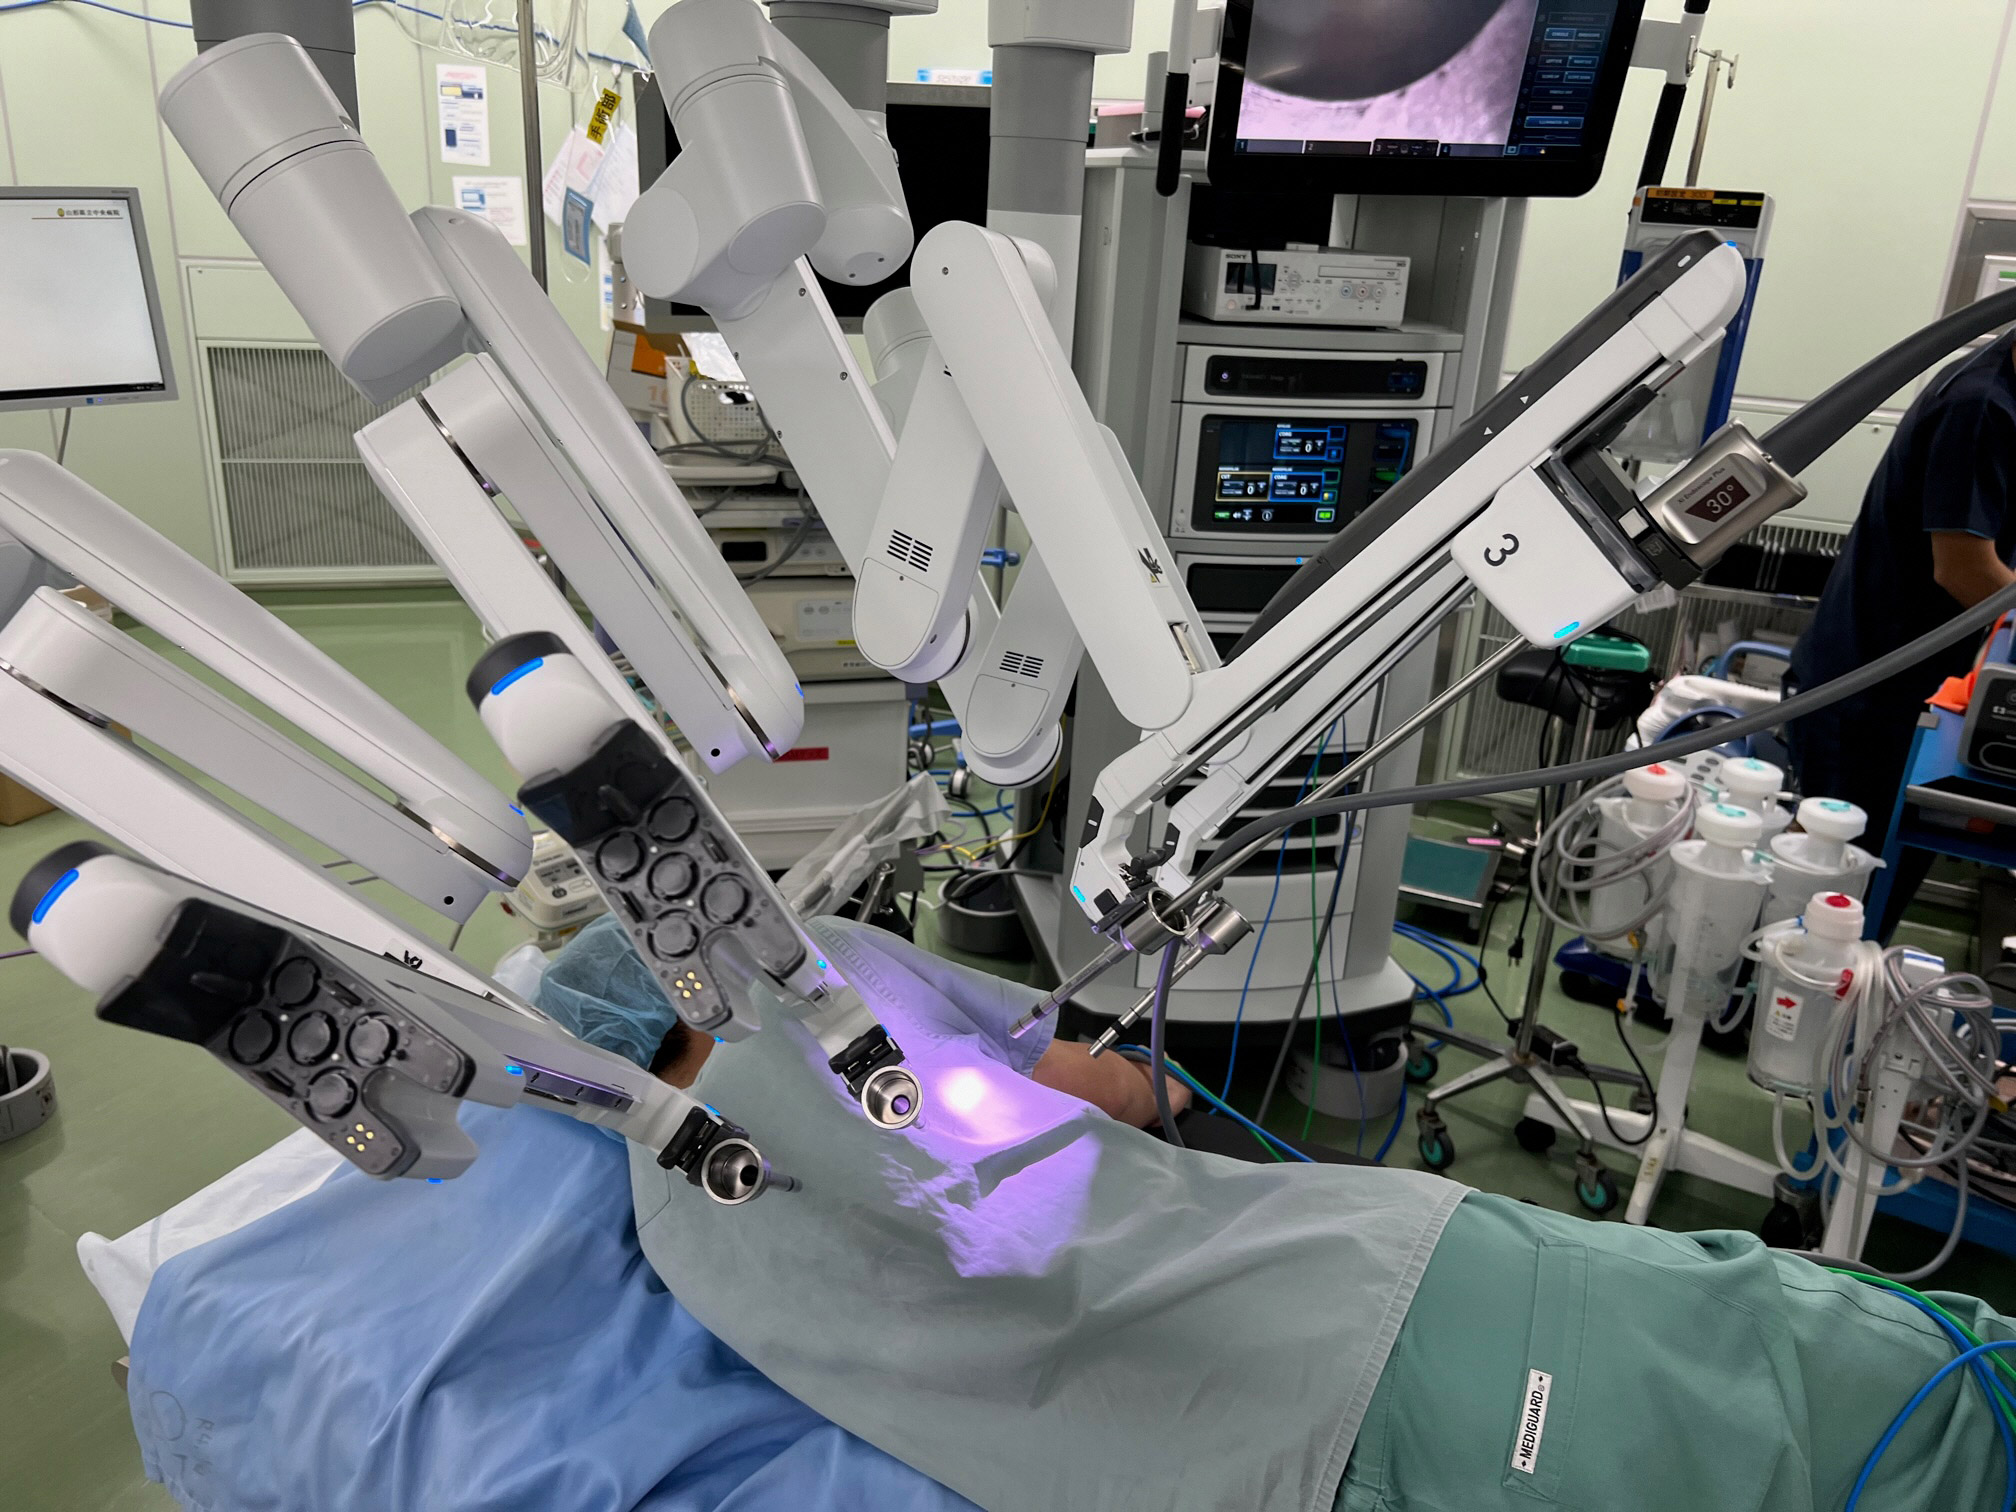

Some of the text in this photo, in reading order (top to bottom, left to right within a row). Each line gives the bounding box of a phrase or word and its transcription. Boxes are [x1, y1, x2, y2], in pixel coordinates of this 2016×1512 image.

[591, 93, 617, 139] 手術部
[1483, 533, 1520, 567] 3
[1519, 1390, 1543, 1459] MEDIGUARD
